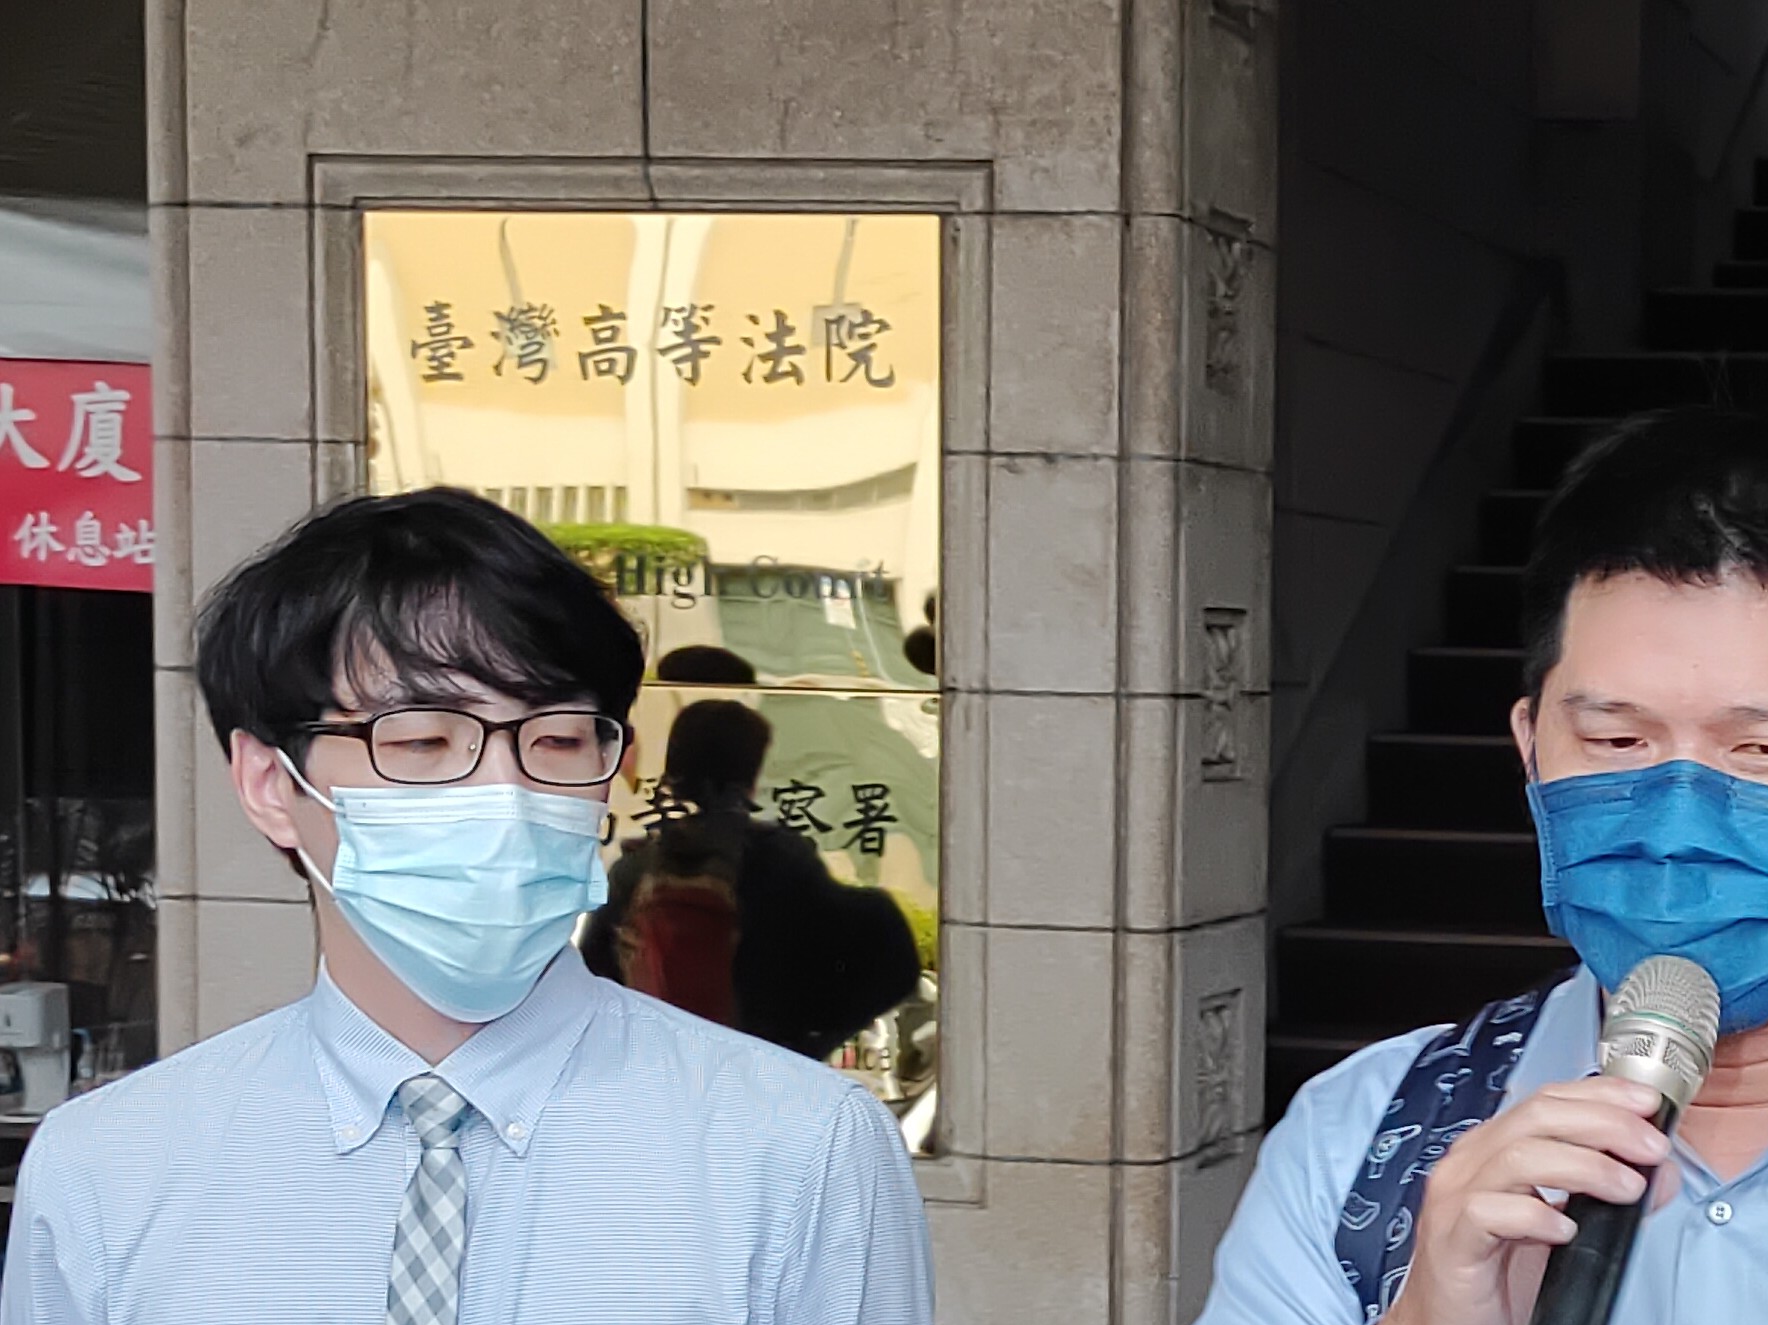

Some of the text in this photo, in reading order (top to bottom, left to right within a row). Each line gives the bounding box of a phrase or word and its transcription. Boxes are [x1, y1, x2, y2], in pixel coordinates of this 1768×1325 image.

[409, 300, 896, 388] 臺灣高等法院
[12, 510, 155, 567] 休息站
[751, 554, 890, 600] Court
